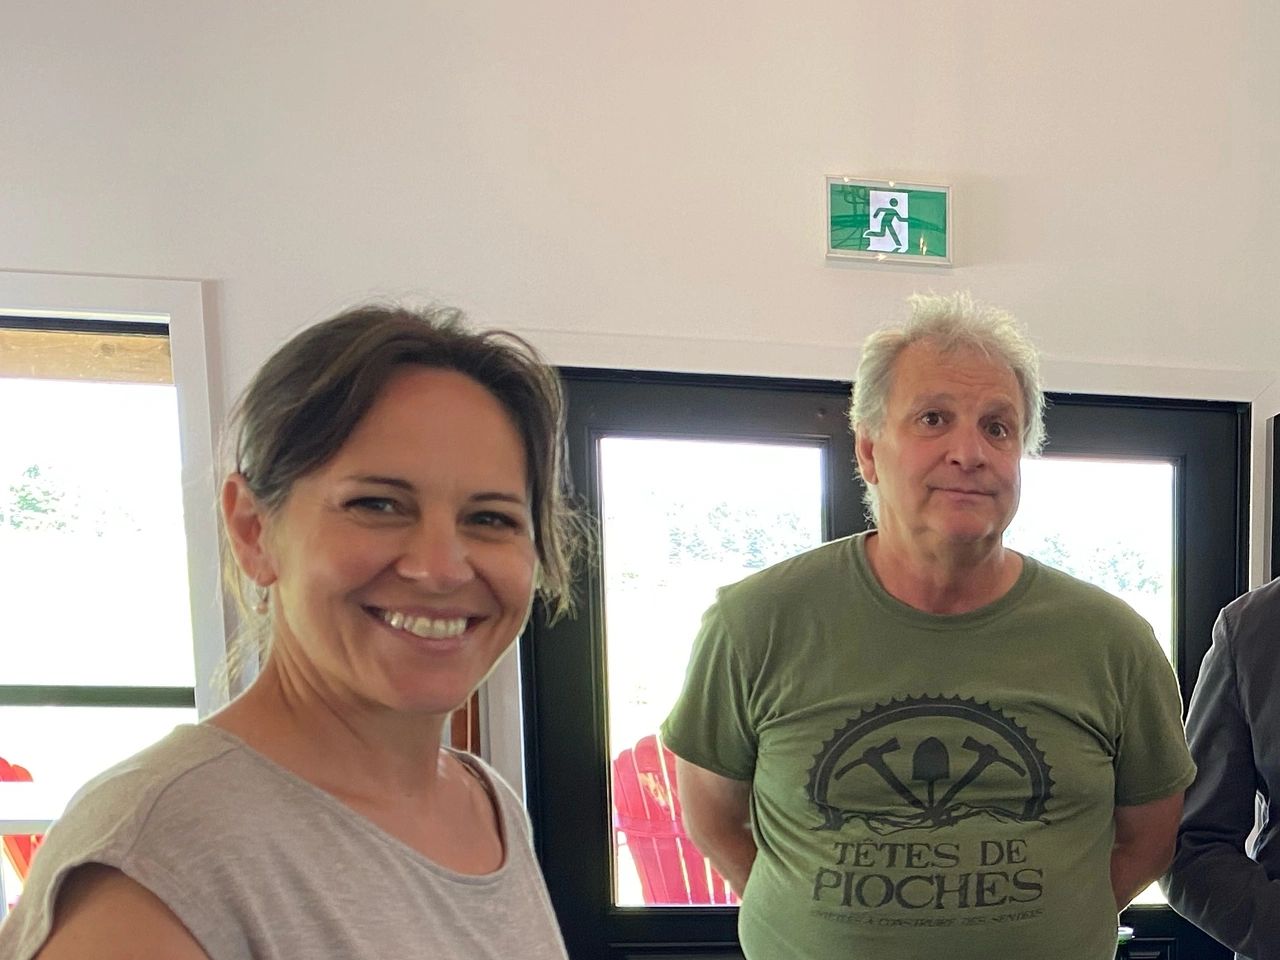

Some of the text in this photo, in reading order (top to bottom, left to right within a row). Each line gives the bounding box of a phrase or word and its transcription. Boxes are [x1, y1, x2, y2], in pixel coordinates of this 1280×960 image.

[834, 839, 1028, 869] TÊTES DE
[812, 867, 1043, 909] PIOCHES
